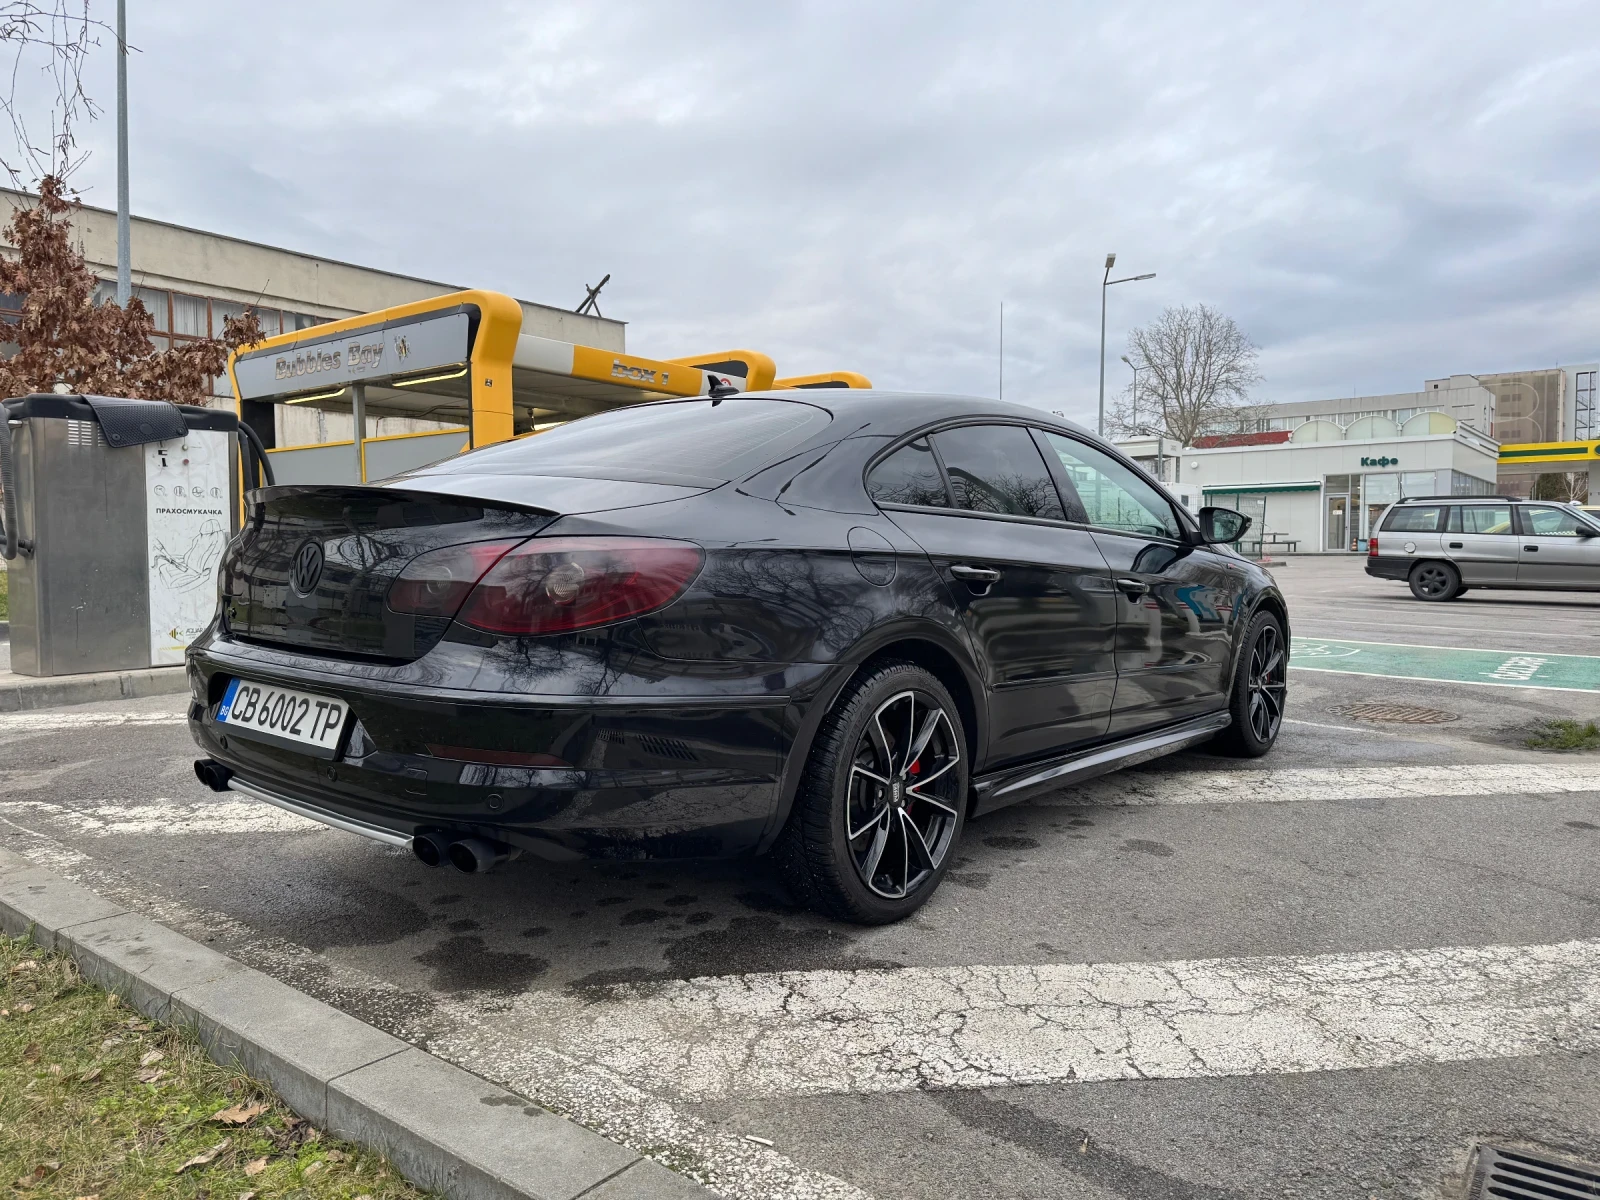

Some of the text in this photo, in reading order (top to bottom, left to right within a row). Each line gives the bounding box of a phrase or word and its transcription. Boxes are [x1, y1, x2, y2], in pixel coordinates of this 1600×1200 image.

[275, 342, 385, 380] Bubbles Bay
[611, 359, 669, 385] box 1
[1360, 456, 1399, 468] Кафе
[156, 507, 223, 516] ПРАХОСМУКАЧКА
[219, 704, 230, 716] BG
